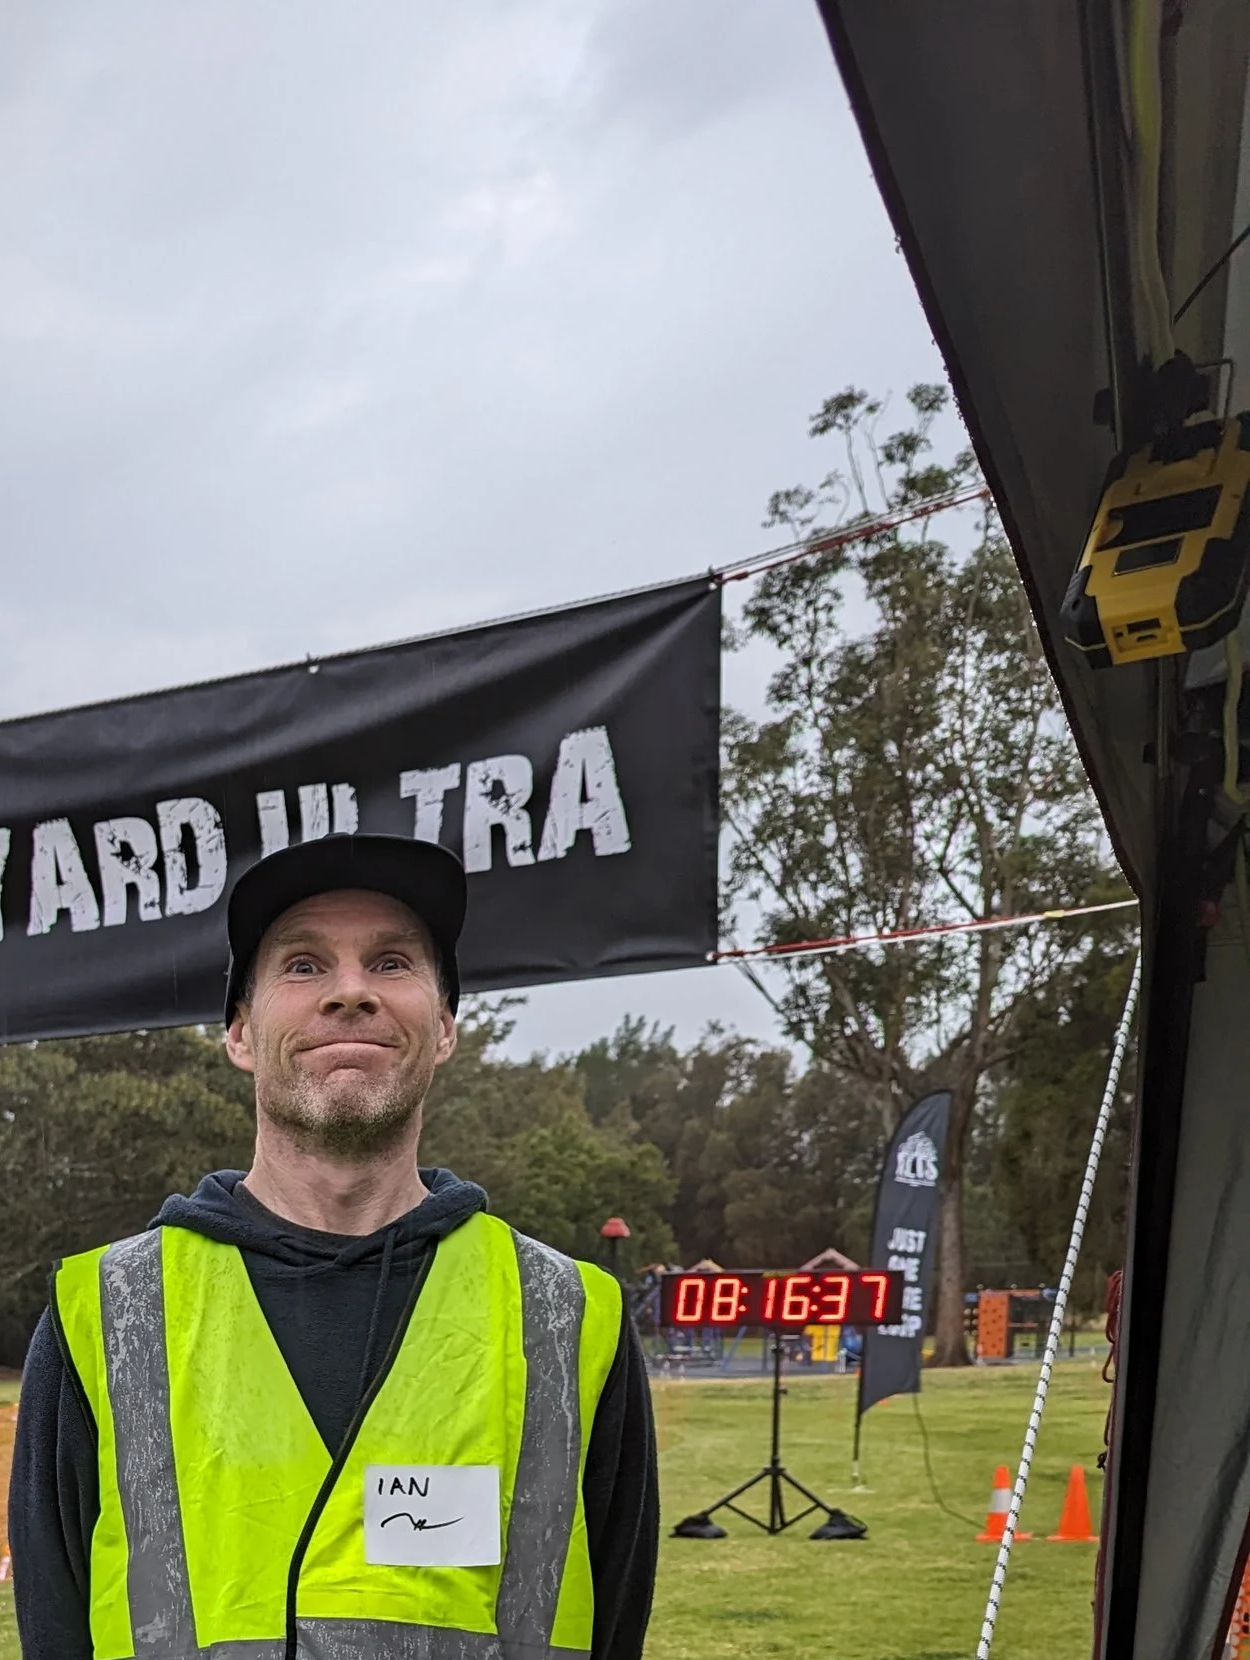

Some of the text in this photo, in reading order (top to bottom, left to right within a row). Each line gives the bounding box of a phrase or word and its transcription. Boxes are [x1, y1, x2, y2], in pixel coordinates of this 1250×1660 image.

[887, 1226, 927, 1253] JUST
[675, 1275, 889, 1322] 08:16:37
[377, 1476, 430, 1497] IAN
